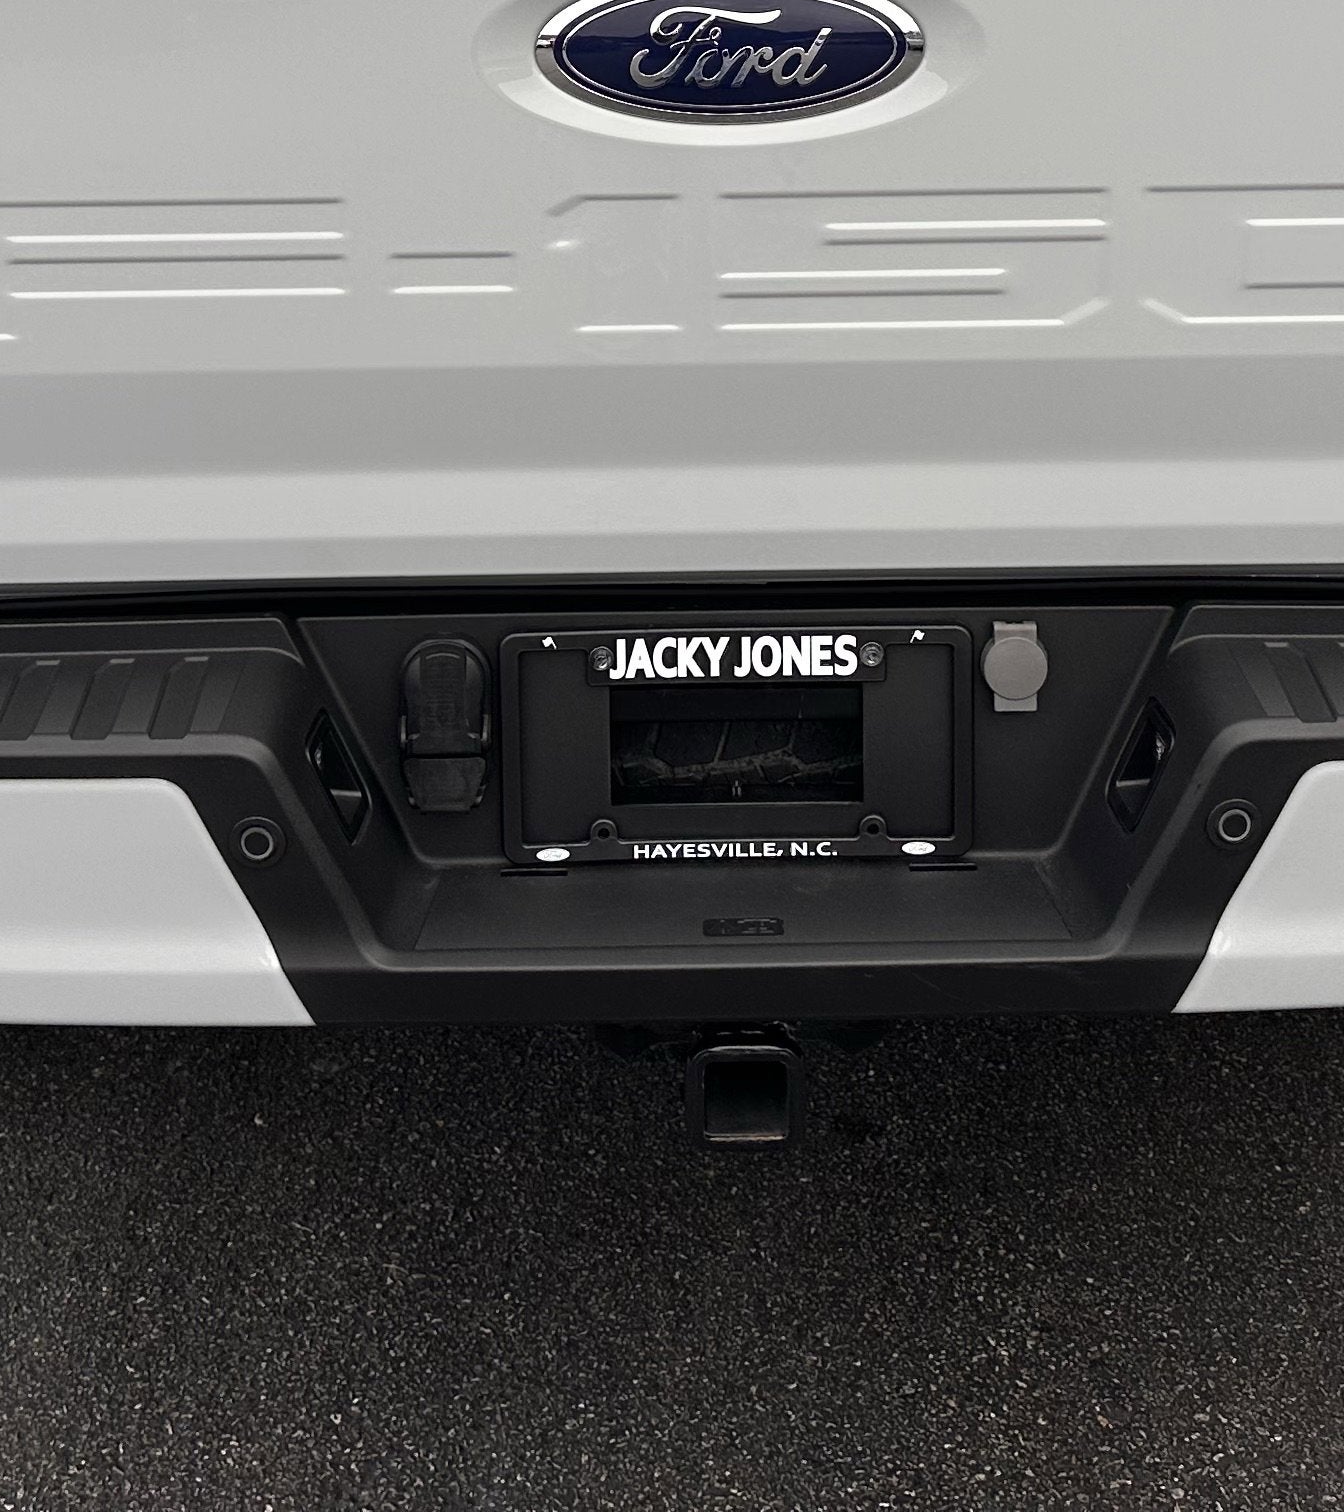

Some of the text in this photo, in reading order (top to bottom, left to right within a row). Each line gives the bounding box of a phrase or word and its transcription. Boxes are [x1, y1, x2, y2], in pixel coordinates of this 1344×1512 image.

[629, 5, 833, 89] Ford
[609, 634, 858, 680] JACKY JONES
[632, 841, 839, 859] HAYESVILLE, N.C.
